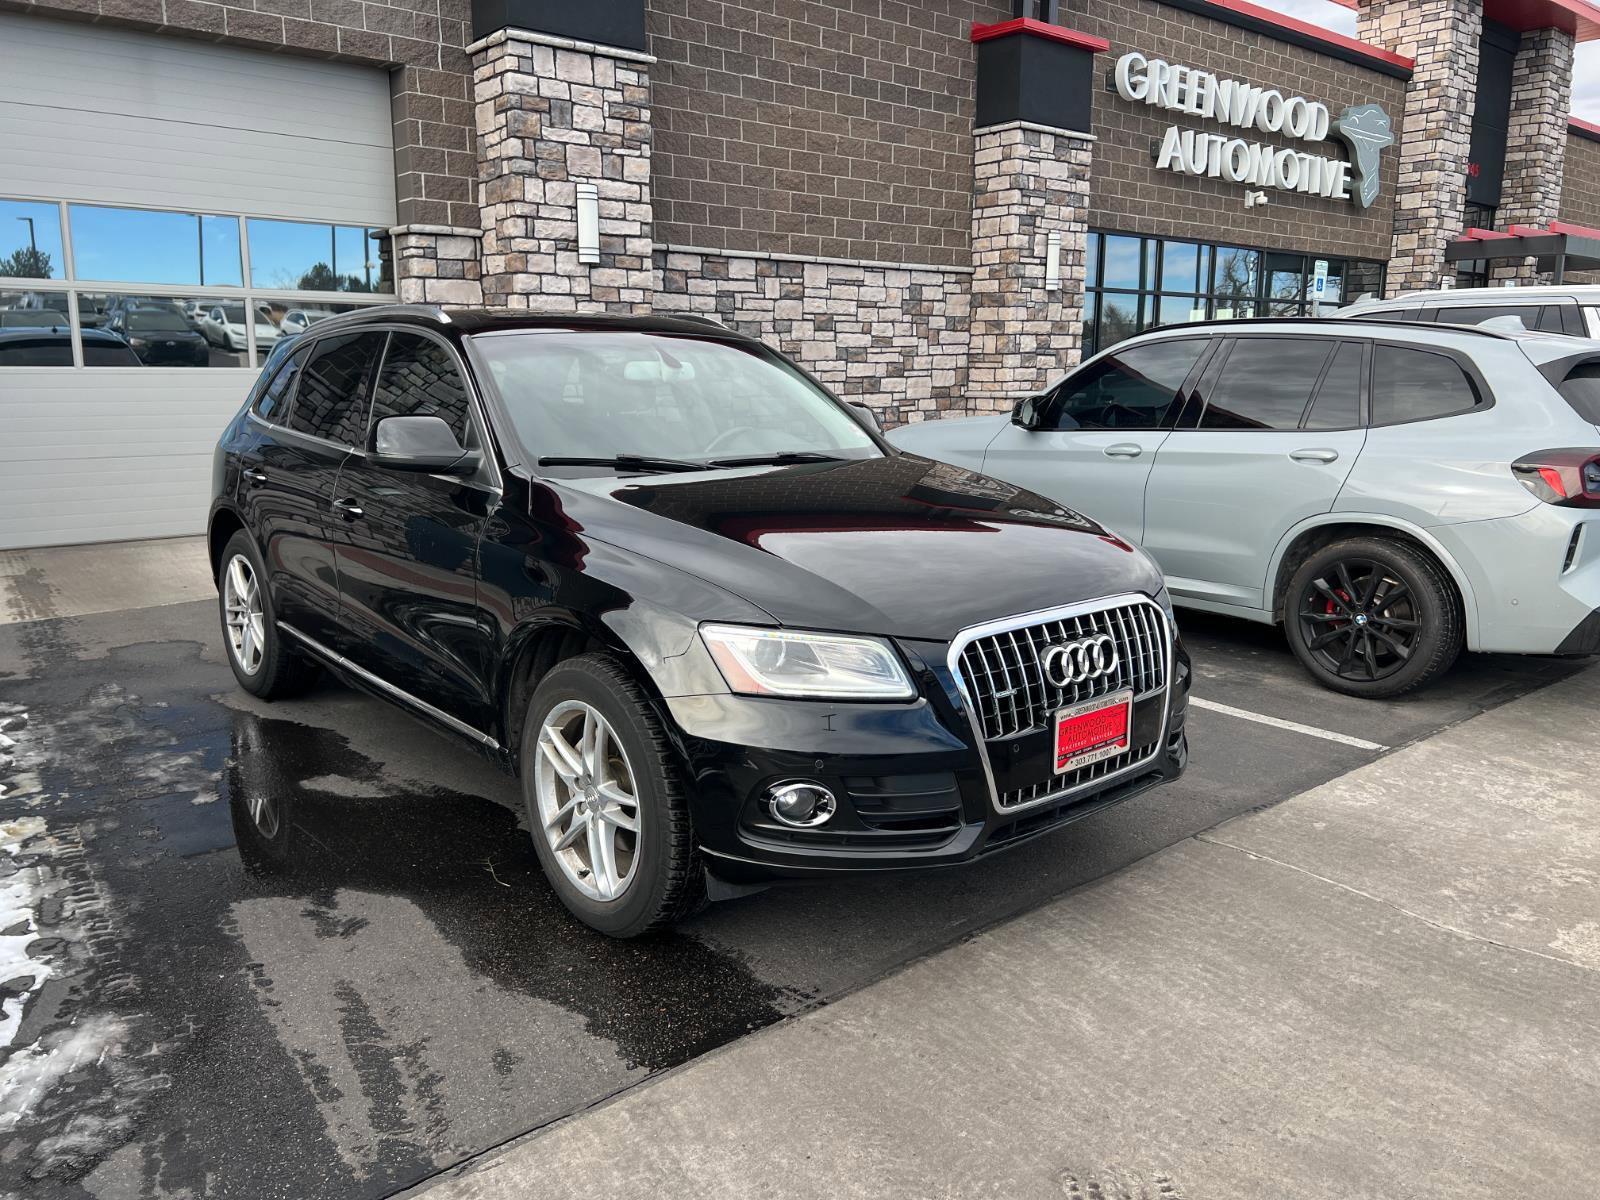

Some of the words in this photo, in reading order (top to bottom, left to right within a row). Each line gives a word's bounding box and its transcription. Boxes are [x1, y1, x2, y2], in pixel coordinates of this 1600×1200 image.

[1115, 52, 1329, 141] GREENWOOD
[1155, 125, 1351, 199] AUTOMOTIVE
[1067, 722, 1113, 742] AUTOMOTIVE
